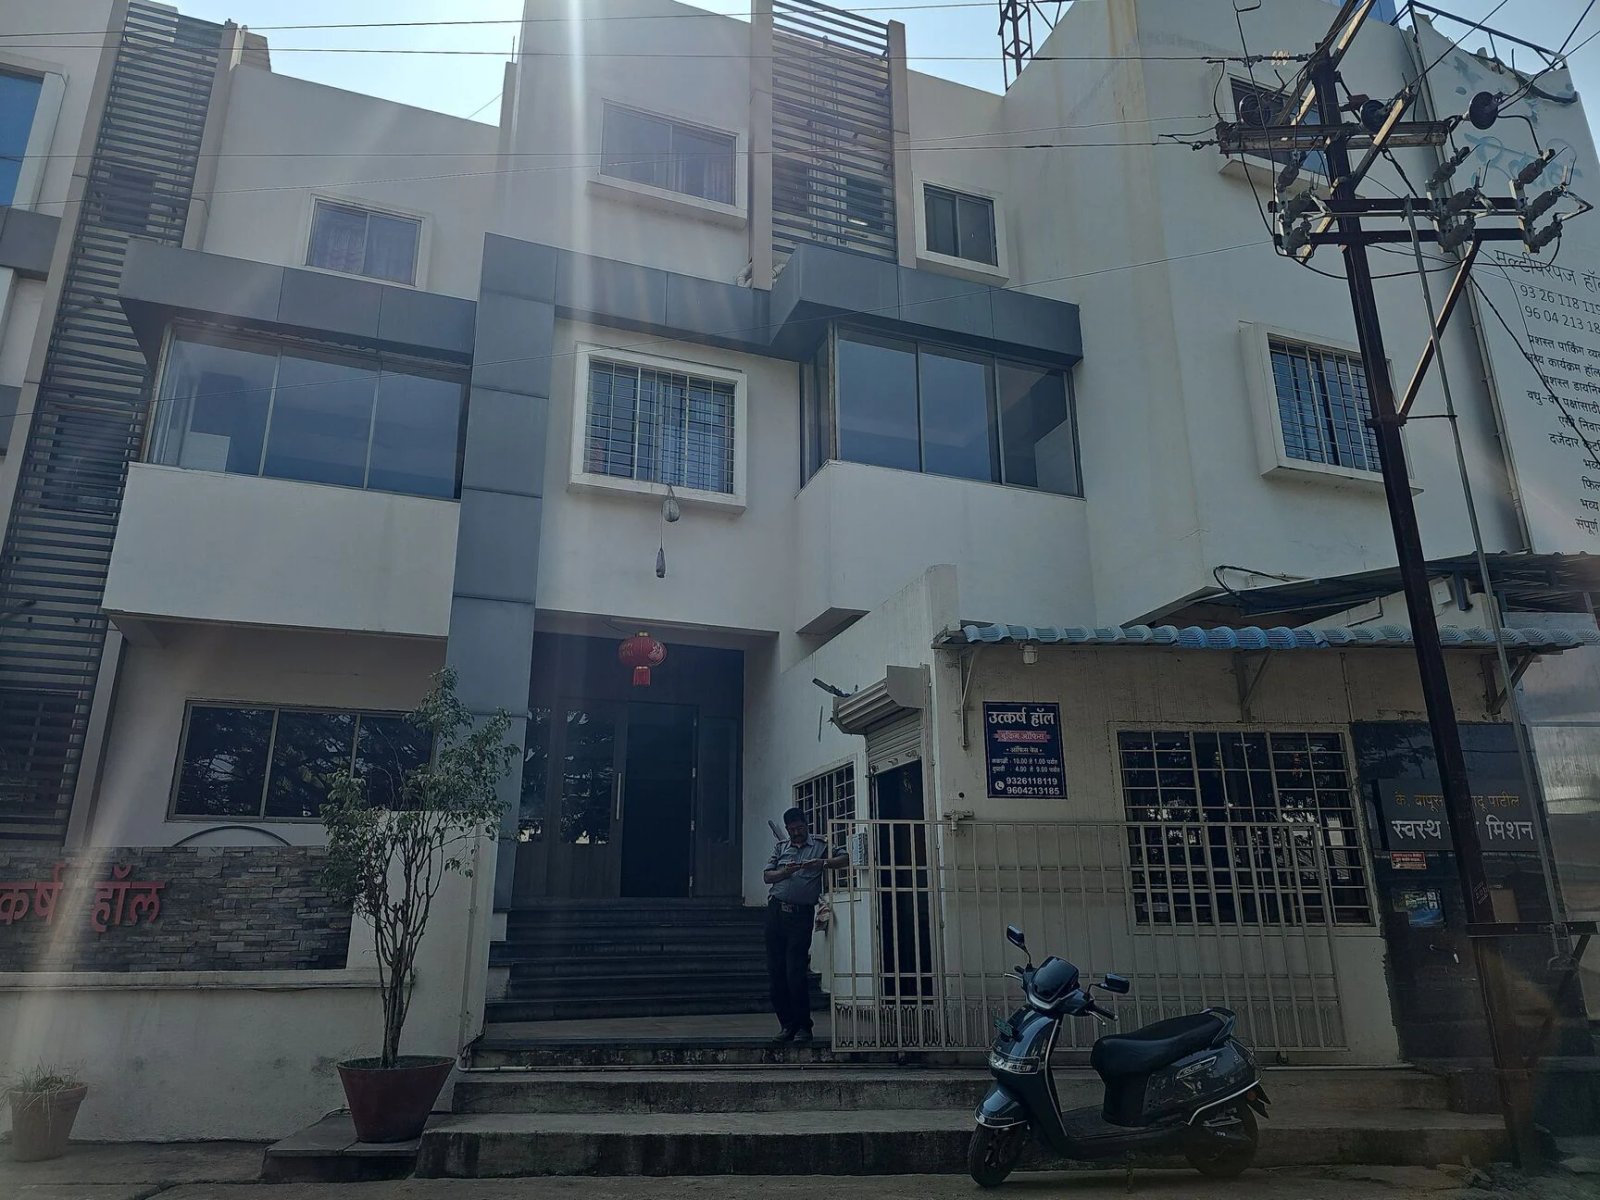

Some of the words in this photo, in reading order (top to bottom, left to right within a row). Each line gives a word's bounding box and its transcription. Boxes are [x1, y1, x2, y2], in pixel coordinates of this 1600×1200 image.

[1581, 269, 1600, 294] हॉ
[1520, 284, 1536, 299] 93
[1540, 289, 1555, 304] 26
[1559, 294, 1580, 311] 118
[1525, 305, 1541, 320] 96
[1543, 310, 1559, 324] 04
[1562, 314, 1584, 331] 213
[988, 707, 1027, 724] उत्कर्ष
[1030, 707, 1055, 727] हॉल
[1006, 777, 1058, 785] 9326118119
[1007, 787, 1060, 795] 9604213185
[1487, 791, 1520, 808] पाटील
[1486, 814, 1534, 841] मिशन
[91, 864, 165, 933] हॉल
